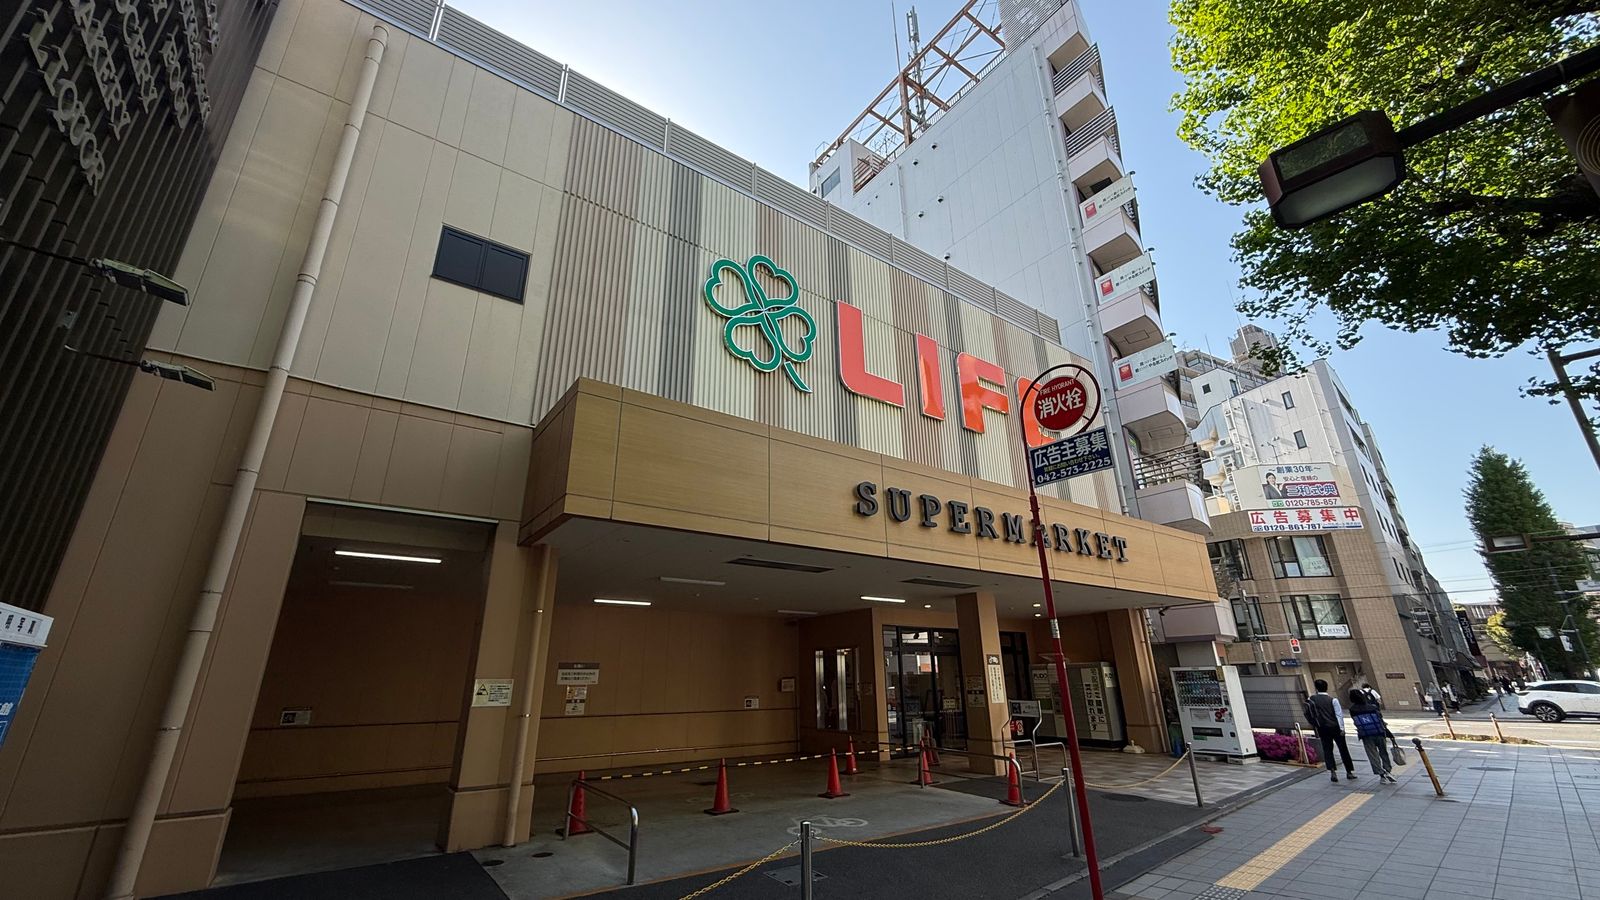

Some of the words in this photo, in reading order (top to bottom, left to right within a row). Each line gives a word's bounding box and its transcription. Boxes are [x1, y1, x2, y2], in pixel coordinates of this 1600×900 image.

[162, 35, 189, 129] FOOD
[26, 8, 105, 196] LIQUOR
[1039, 386, 1051, 396] FIRE
[1051, 379, 1075, 392] HYDRANT
[1037, 387, 1084, 420] 消火栓
[1034, 431, 1108, 469] 広告主募集
[1036, 456, 1111, 484] 042-573-2225
[1286, 483, 1338, 497] 三和式典
[1285, 498, 1338, 507] 0120-785-857
[1250, 508, 1360, 525] 広告募集中
[1263, 523, 1321, 531] 0120-861-787
